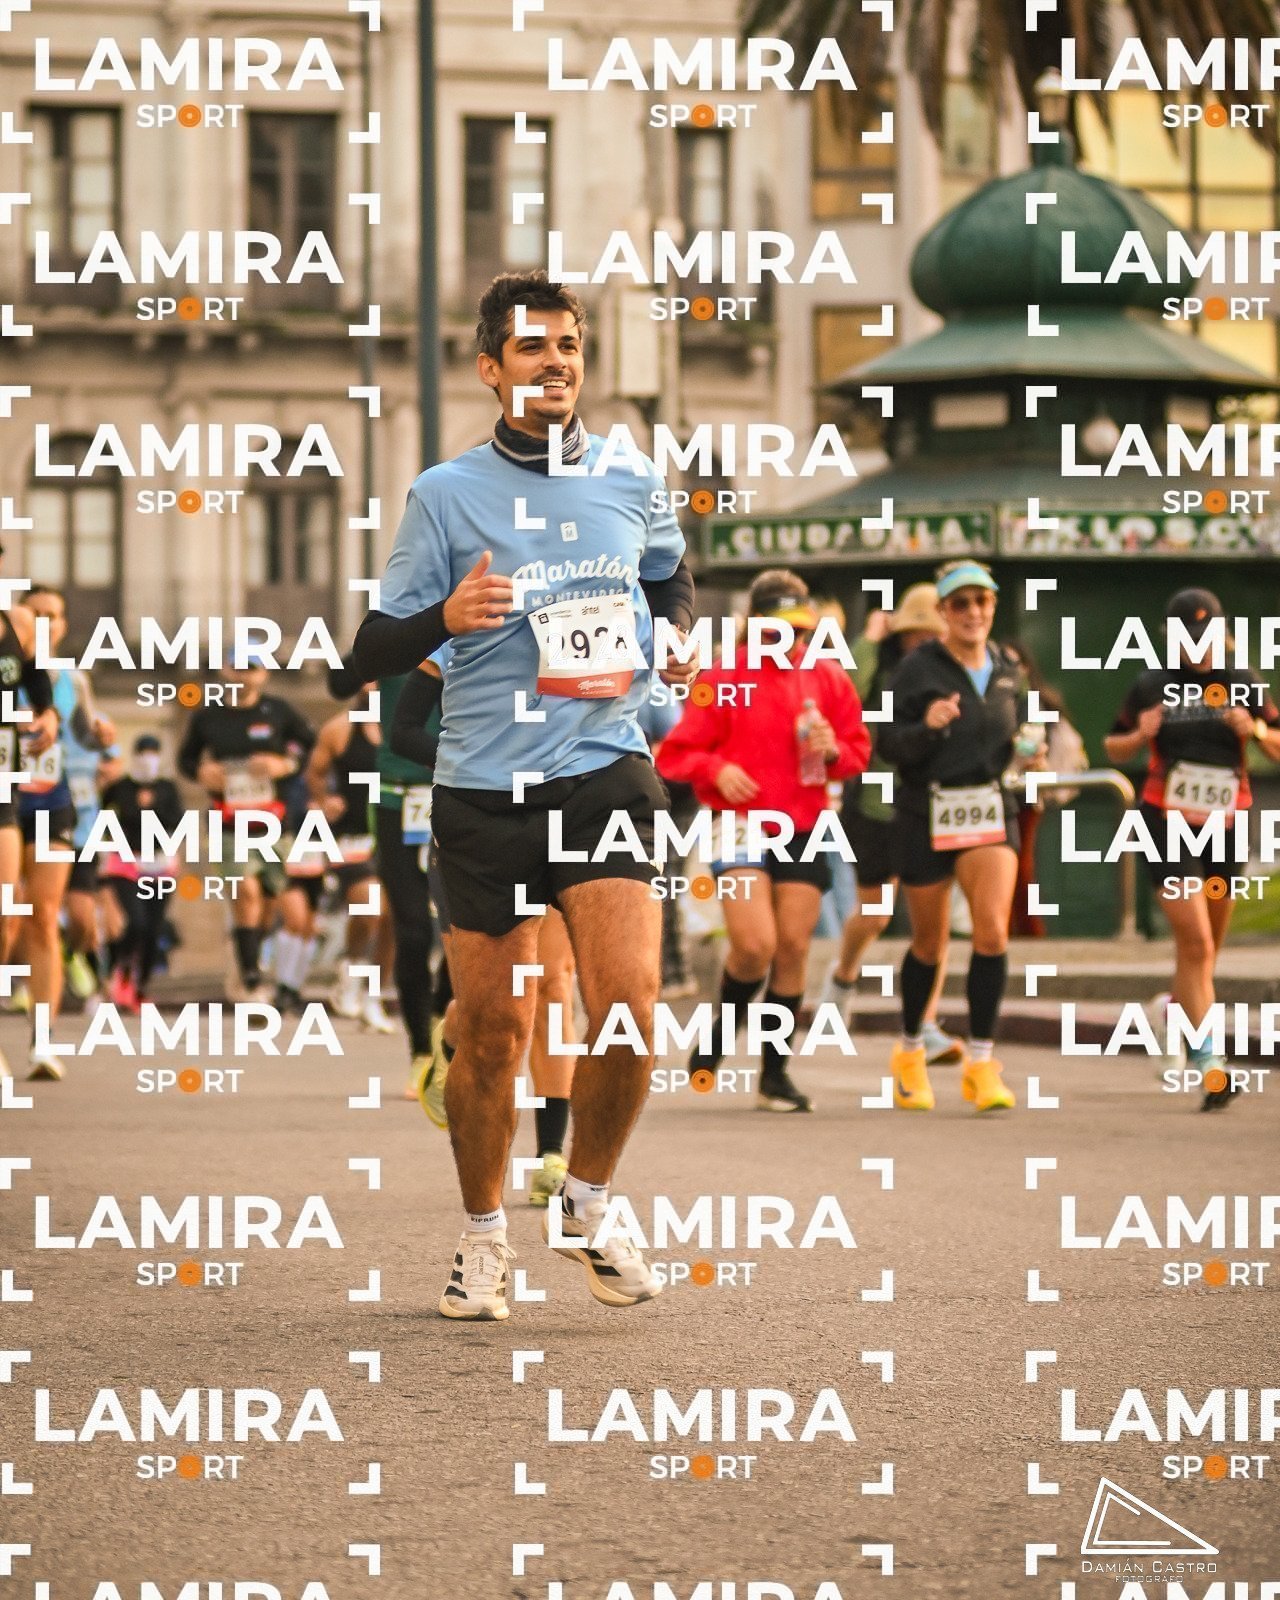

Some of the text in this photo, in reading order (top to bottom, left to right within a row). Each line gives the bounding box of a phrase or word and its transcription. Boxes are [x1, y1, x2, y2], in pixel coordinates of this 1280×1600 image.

[512, 553, 637, 590] Maratón
[1174, 781, 1232, 806] 4150
[938, 804, 996, 827] 4994
